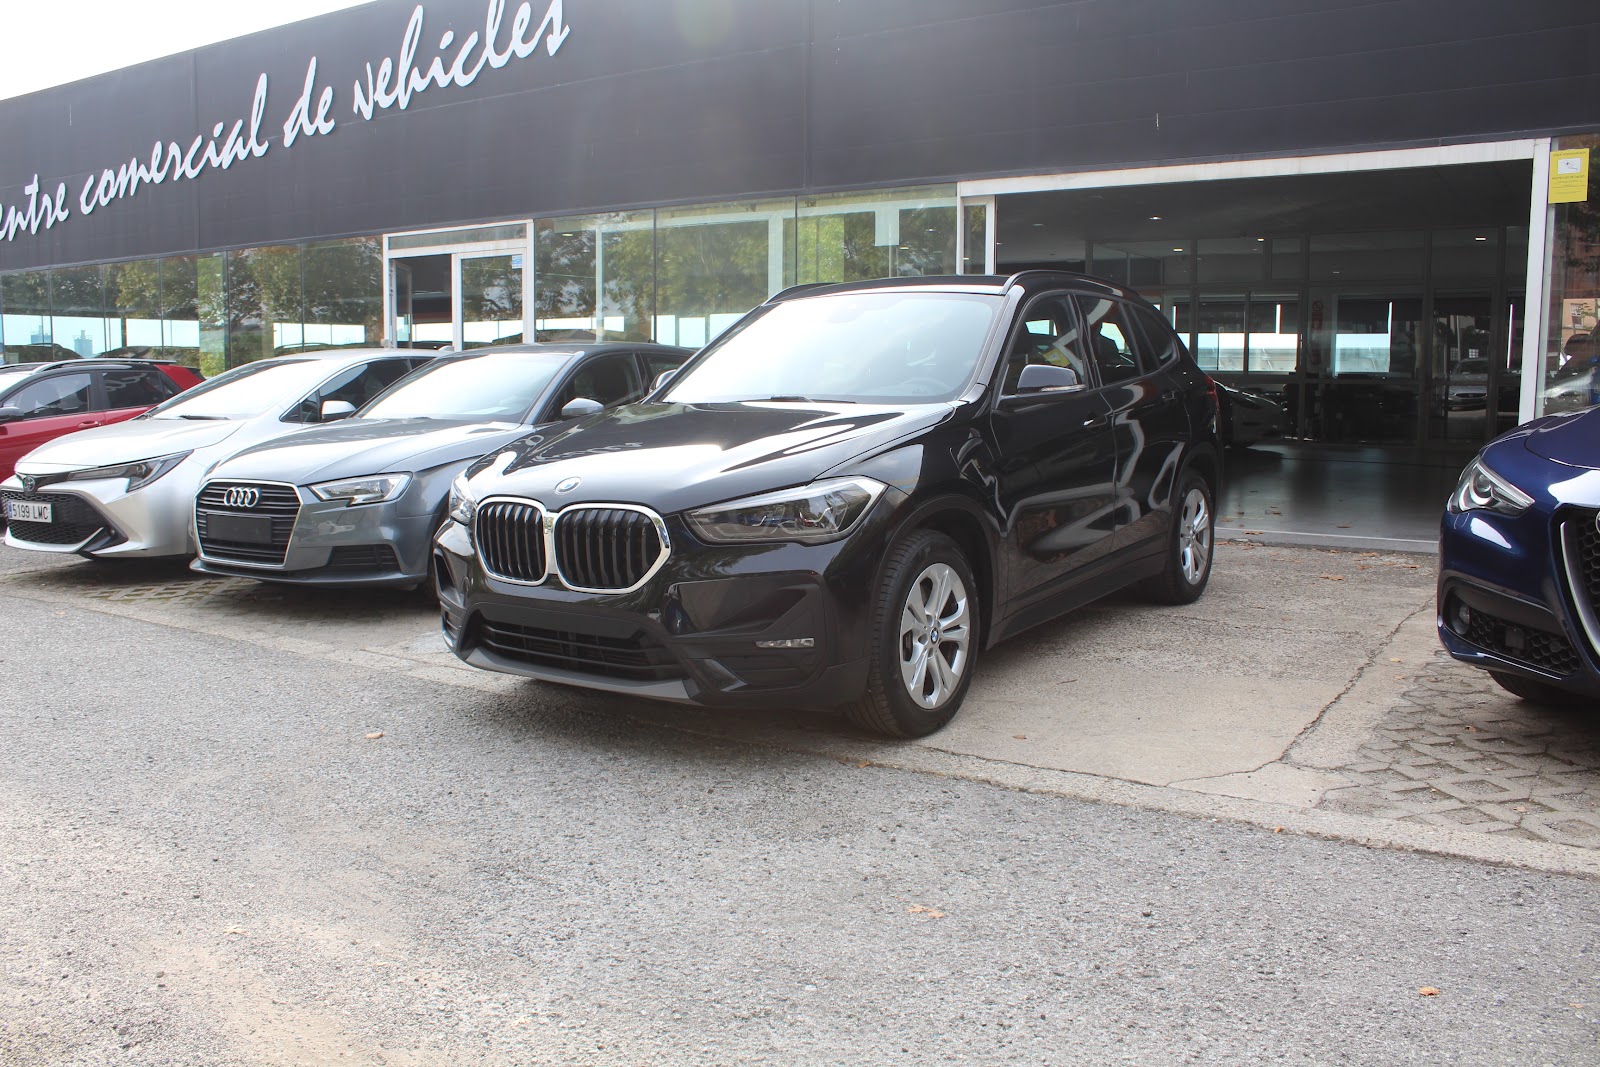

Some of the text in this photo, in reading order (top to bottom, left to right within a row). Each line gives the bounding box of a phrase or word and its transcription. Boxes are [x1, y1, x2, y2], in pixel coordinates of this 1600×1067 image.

[80, 73, 269, 215] comercial
[283, 56, 335, 148] de
[353, 0, 571, 120] vehicles
[12, 503, 49, 520] 5199 LMC
